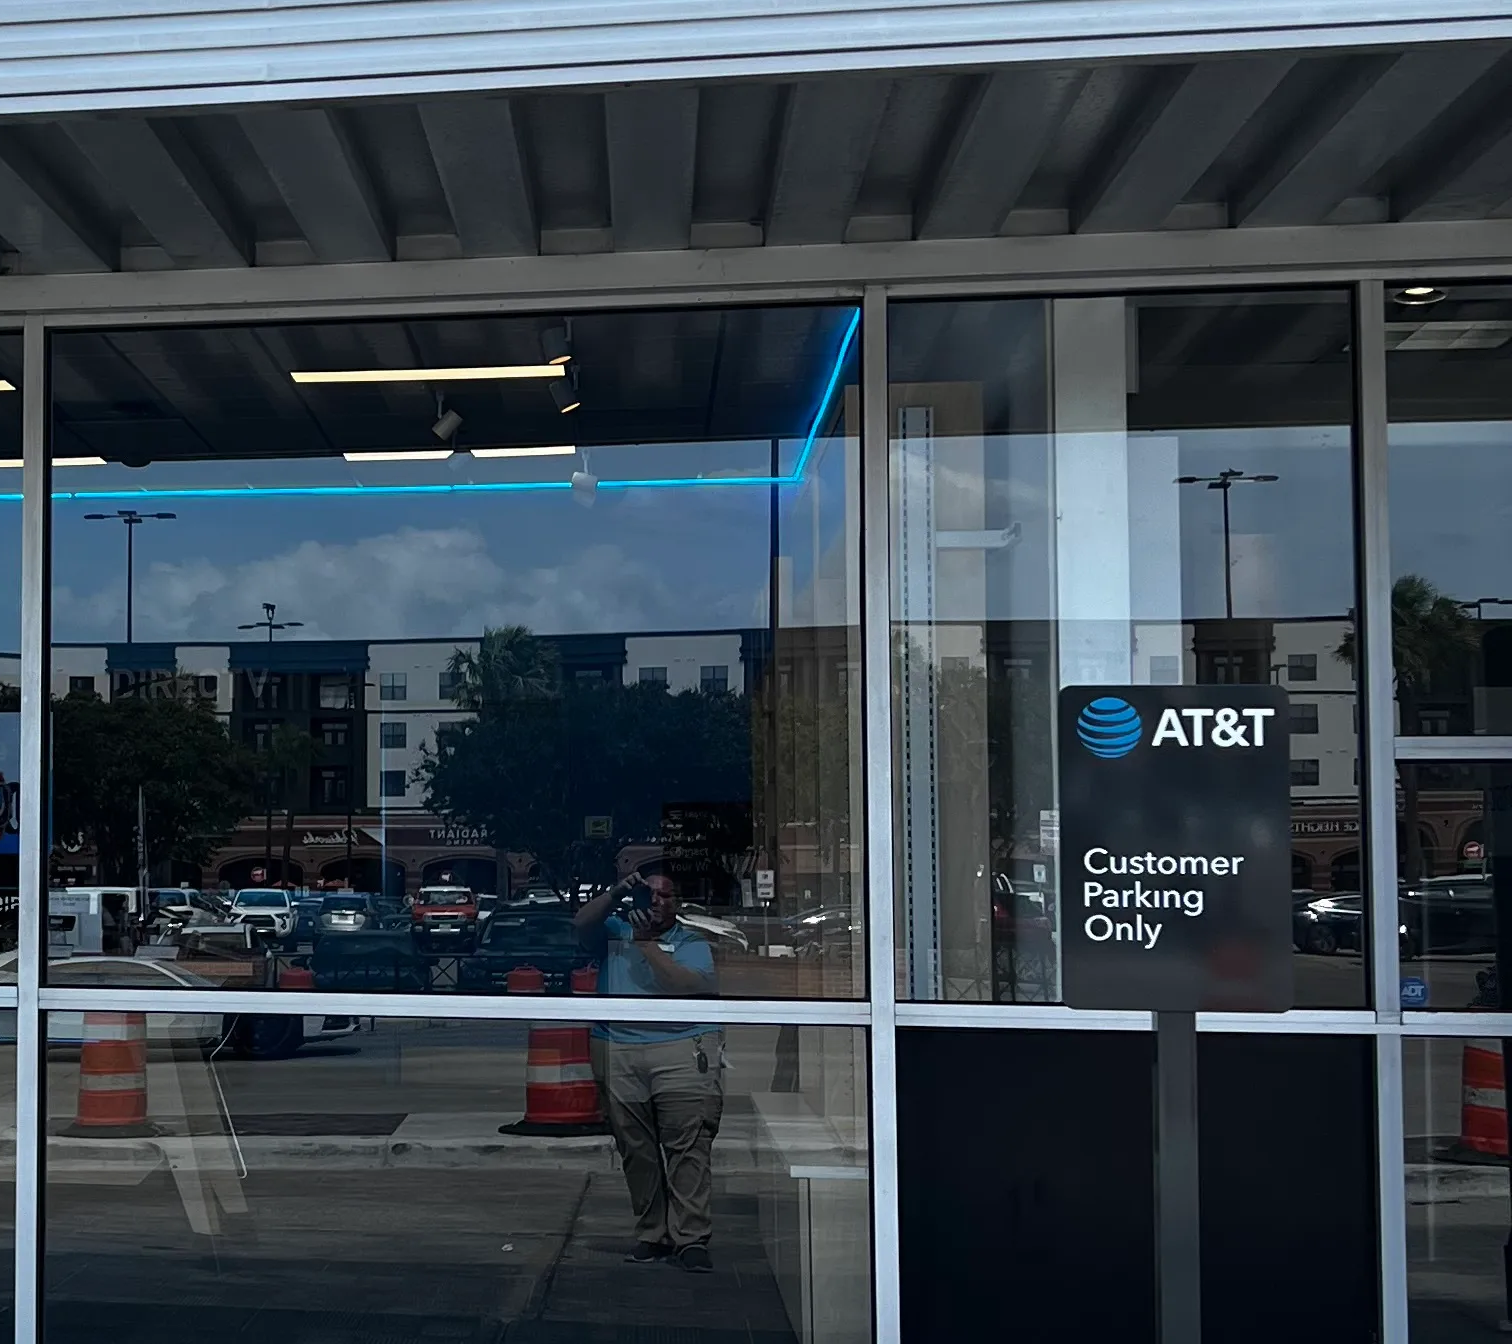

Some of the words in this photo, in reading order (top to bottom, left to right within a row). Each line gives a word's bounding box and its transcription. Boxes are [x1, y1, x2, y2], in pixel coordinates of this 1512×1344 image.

[1151, 707, 1275, 747] AT&T
[1084, 847, 1245, 875] Customer
[1084, 881, 1204, 917] Parking
[1084, 913, 1163, 949] Only
[1401, 985, 1425, 997] ADT
